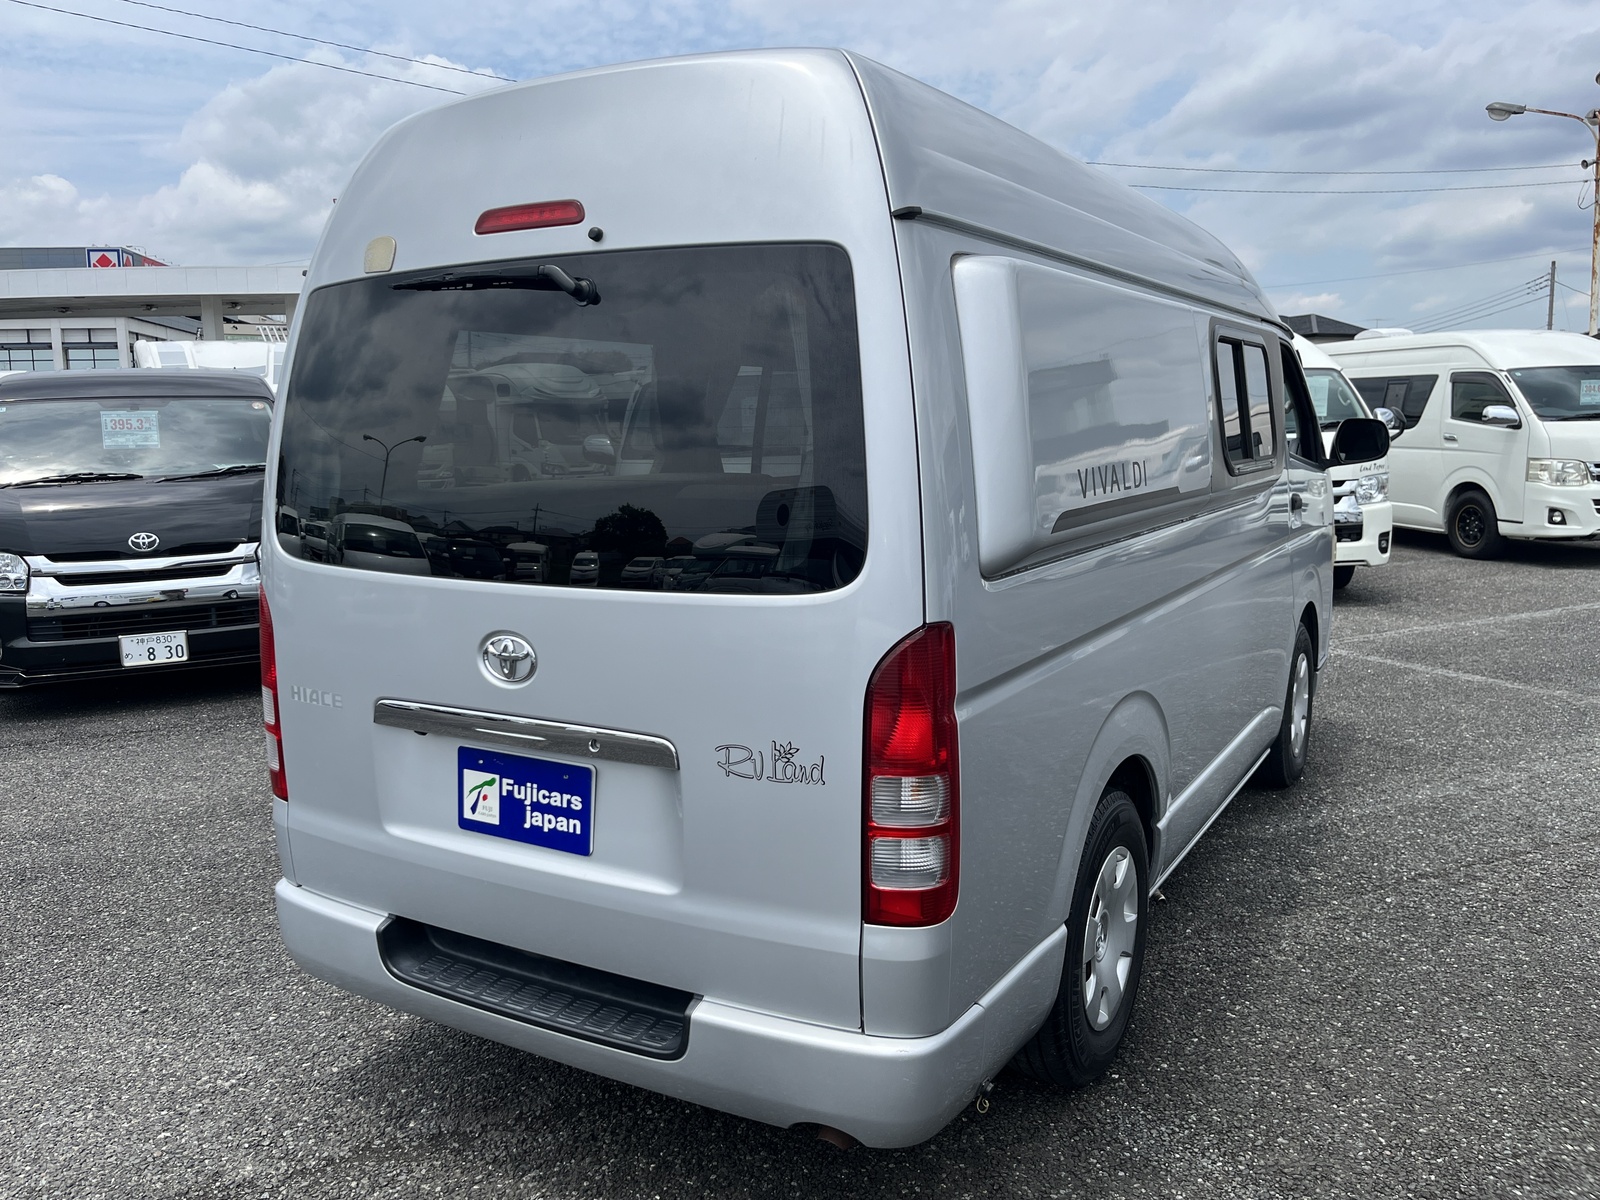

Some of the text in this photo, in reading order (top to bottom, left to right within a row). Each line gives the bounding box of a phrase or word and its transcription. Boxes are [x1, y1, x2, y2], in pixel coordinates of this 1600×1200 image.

[110, 418, 144, 430] 395.3
[1077, 460, 1148, 499] VIVALDI
[290, 685, 343, 709] HIACE
[766, 739, 826, 786] Land
[501, 777, 583, 811] Fujicars
[523, 805, 582, 835] japan
